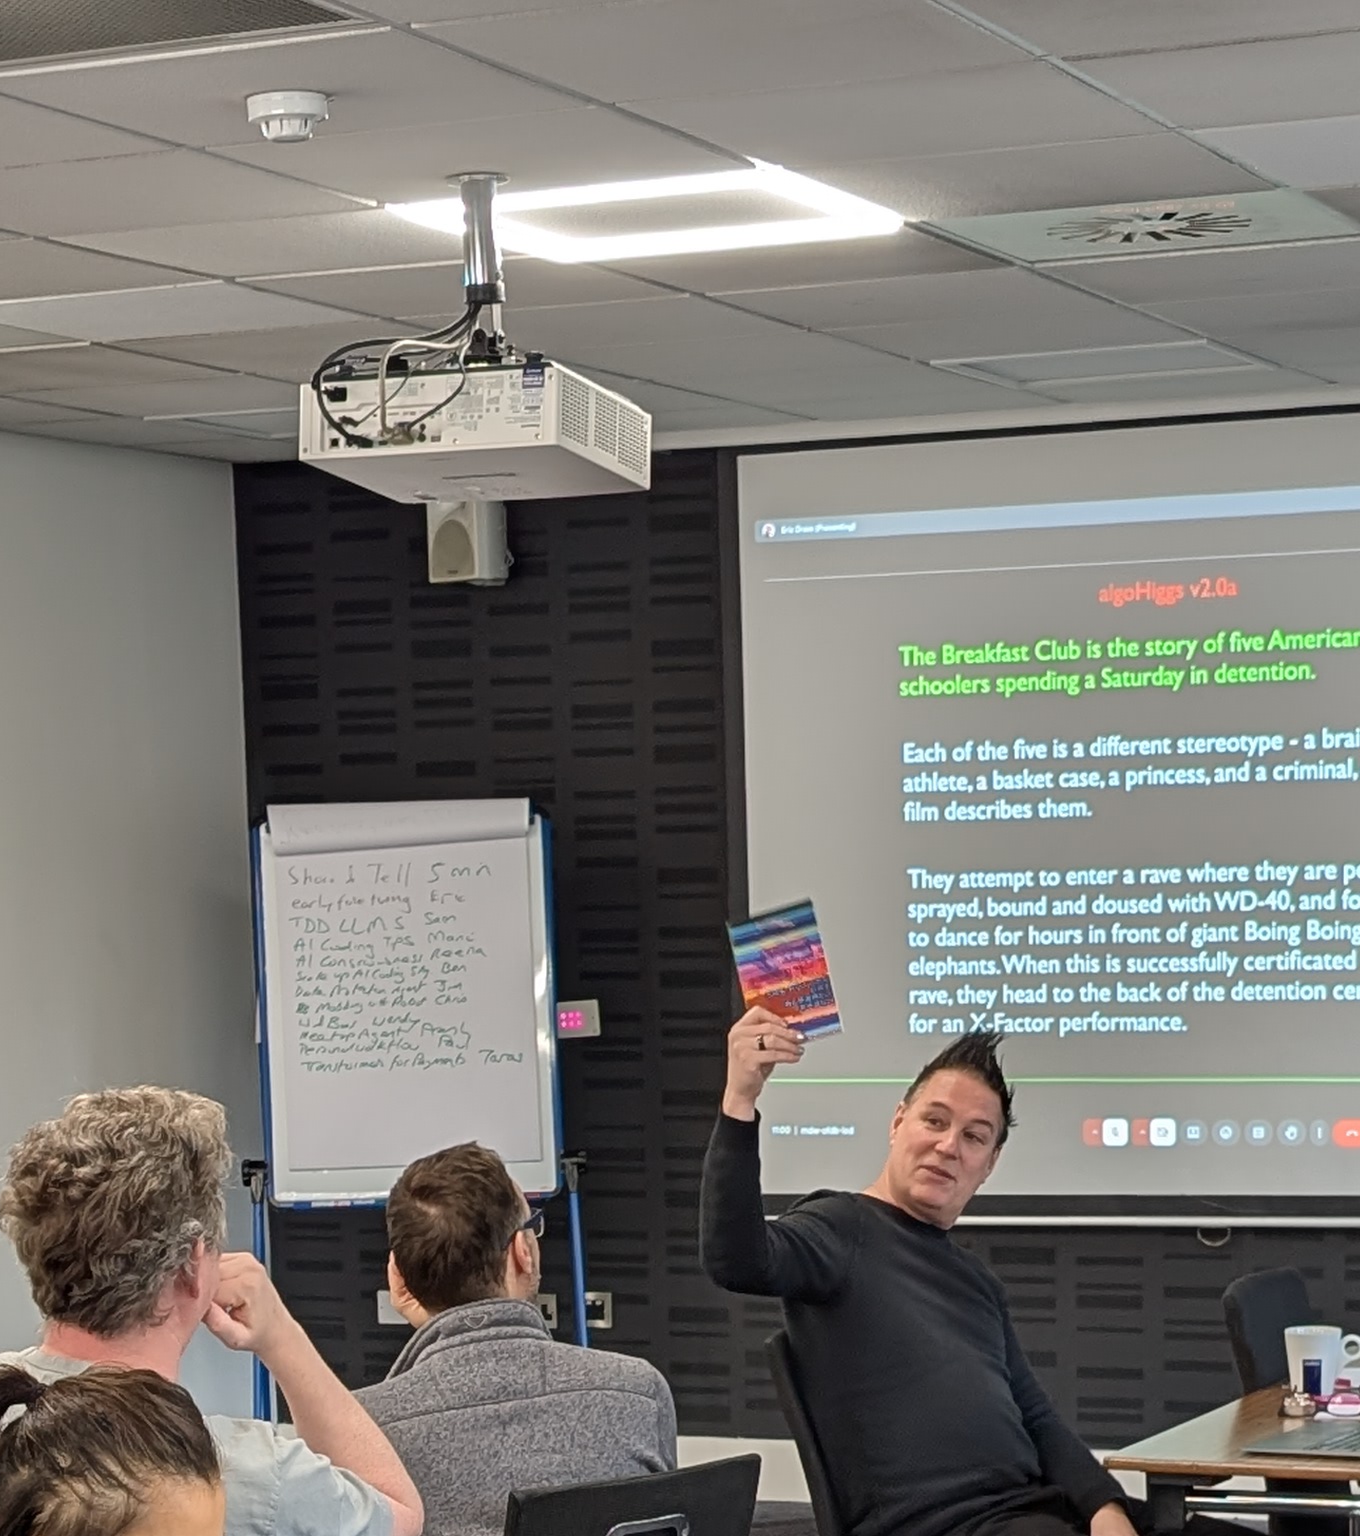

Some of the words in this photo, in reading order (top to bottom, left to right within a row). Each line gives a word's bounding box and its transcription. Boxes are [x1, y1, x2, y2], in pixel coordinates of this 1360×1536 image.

[1099, 581, 1184, 607] algoHiggs
[1190, 577, 1238, 598] v2.0a
[899, 646, 936, 666] The
[943, 642, 1030, 664] Breakfast
[1035, 639, 1081, 660] Club
[1087, 640, 1102, 658] is
[1107, 637, 1139, 658] the
[1145, 640, 1198, 660] story
[1203, 631, 1226, 653] of
[1229, 631, 1264, 652] five
[900, 674, 990, 696] schoolers
[996, 671, 1080, 697] spending
[1085, 674, 1096, 689] a
[1101, 665, 1185, 691] Saturday
[1190, 666, 1208, 684] in
[1214, 661, 1316, 683] detention.
[904, 742, 946, 763] Each
[952, 740, 973, 762] of
[977, 740, 1008, 761] the
[1013, 738, 1047, 759] five
[1053, 739, 1068, 758] is
[1073, 743, 1085, 758] a
[1089, 735, 1171, 757] different
[1177, 735, 1284, 757] stereotype
[1304, 734, 1316, 749] a
[903, 772, 973, 793] athlete,
[976, 776, 987, 790] a
[993, 769, 1054, 790] basket
[1059, 772, 1105, 789] case,
[1108, 771, 1120, 786] a
[1126, 765, 1211, 791] princess,
[1214, 761, 1250, 783] and
[1255, 766, 1267, 781] a
[1273, 758, 1358, 781] criminal,
[904, 801, 939, 821] film
[944, 799, 1033, 821] describes
[1038, 798, 1092, 818] them.
[367, 862, 411, 887] Tell
[427, 862, 446, 883] 5
[451, 864, 492, 877] min
[907, 868, 955, 894] They
[959, 871, 1034, 893] attempt
[1039, 870, 1061, 886] to
[1065, 869, 1118, 886] enter
[1123, 869, 1135, 884] a
[1140, 868, 1182, 884] rave
[1186, 862, 1249, 883] where
[1255, 860, 1299, 886] they
[1304, 864, 1337, 880] are
[292, 894, 332, 912] early
[430, 889, 466, 904] Eric
[908, 897, 983, 923] sprayed,
[987, 896, 1047, 916] bound
[1052, 894, 1086, 915] and
[1092, 893, 1163, 914] doused
[1167, 892, 1211, 912] with
[1214, 889, 1295, 912] WD-40,
[1299, 889, 1336, 910] and
[288, 916, 330, 934] TDD
[424, 911, 457, 926] Sam
[908, 932, 929, 947] to
[935, 927, 989, 946] dance
[994, 926, 1023, 945] for
[1029, 926, 1083, 945] hours
[1089, 925, 1106, 943] in
[1111, 923, 1161, 943] front
[1166, 922, 1188, 942] of
[1191, 923, 1239, 948] giant
[1245, 921, 1300, 946] Boing
[293, 937, 313, 953] AI
[320, 938, 375, 959] Coding
[295, 953, 313, 968] AI
[351, 968, 370, 980] AI
[371, 966, 405, 984] Coding
[440, 961, 467, 975] Ben
[909, 956, 1001, 981] elephants.
[1001, 954, 1060, 974] When
[1066, 954, 1100, 973] this
[1106, 954, 1121, 973] is
[1127, 951, 1238, 977] successfully
[1244, 949, 1357, 971] certificated
[909, 990, 953, 1006] rave,
[957, 985, 997, 1009] they
[1003, 983, 1047, 1003] head
[1053, 988, 1074, 1003] to
[1079, 982, 1111, 1002] the
[1117, 982, 1162, 1002] back
[1167, 981, 1189, 1001] of
[1193, 981, 1225, 1001] the
[1231, 981, 1326, 1001] detention
[909, 1013, 937, 1033] for
[942, 1019, 964, 1033] an
[970, 1012, 1054, 1032] X-Factor
[1060, 1011, 1187, 1037] performance.
[389, 1054, 410, 1071] for
